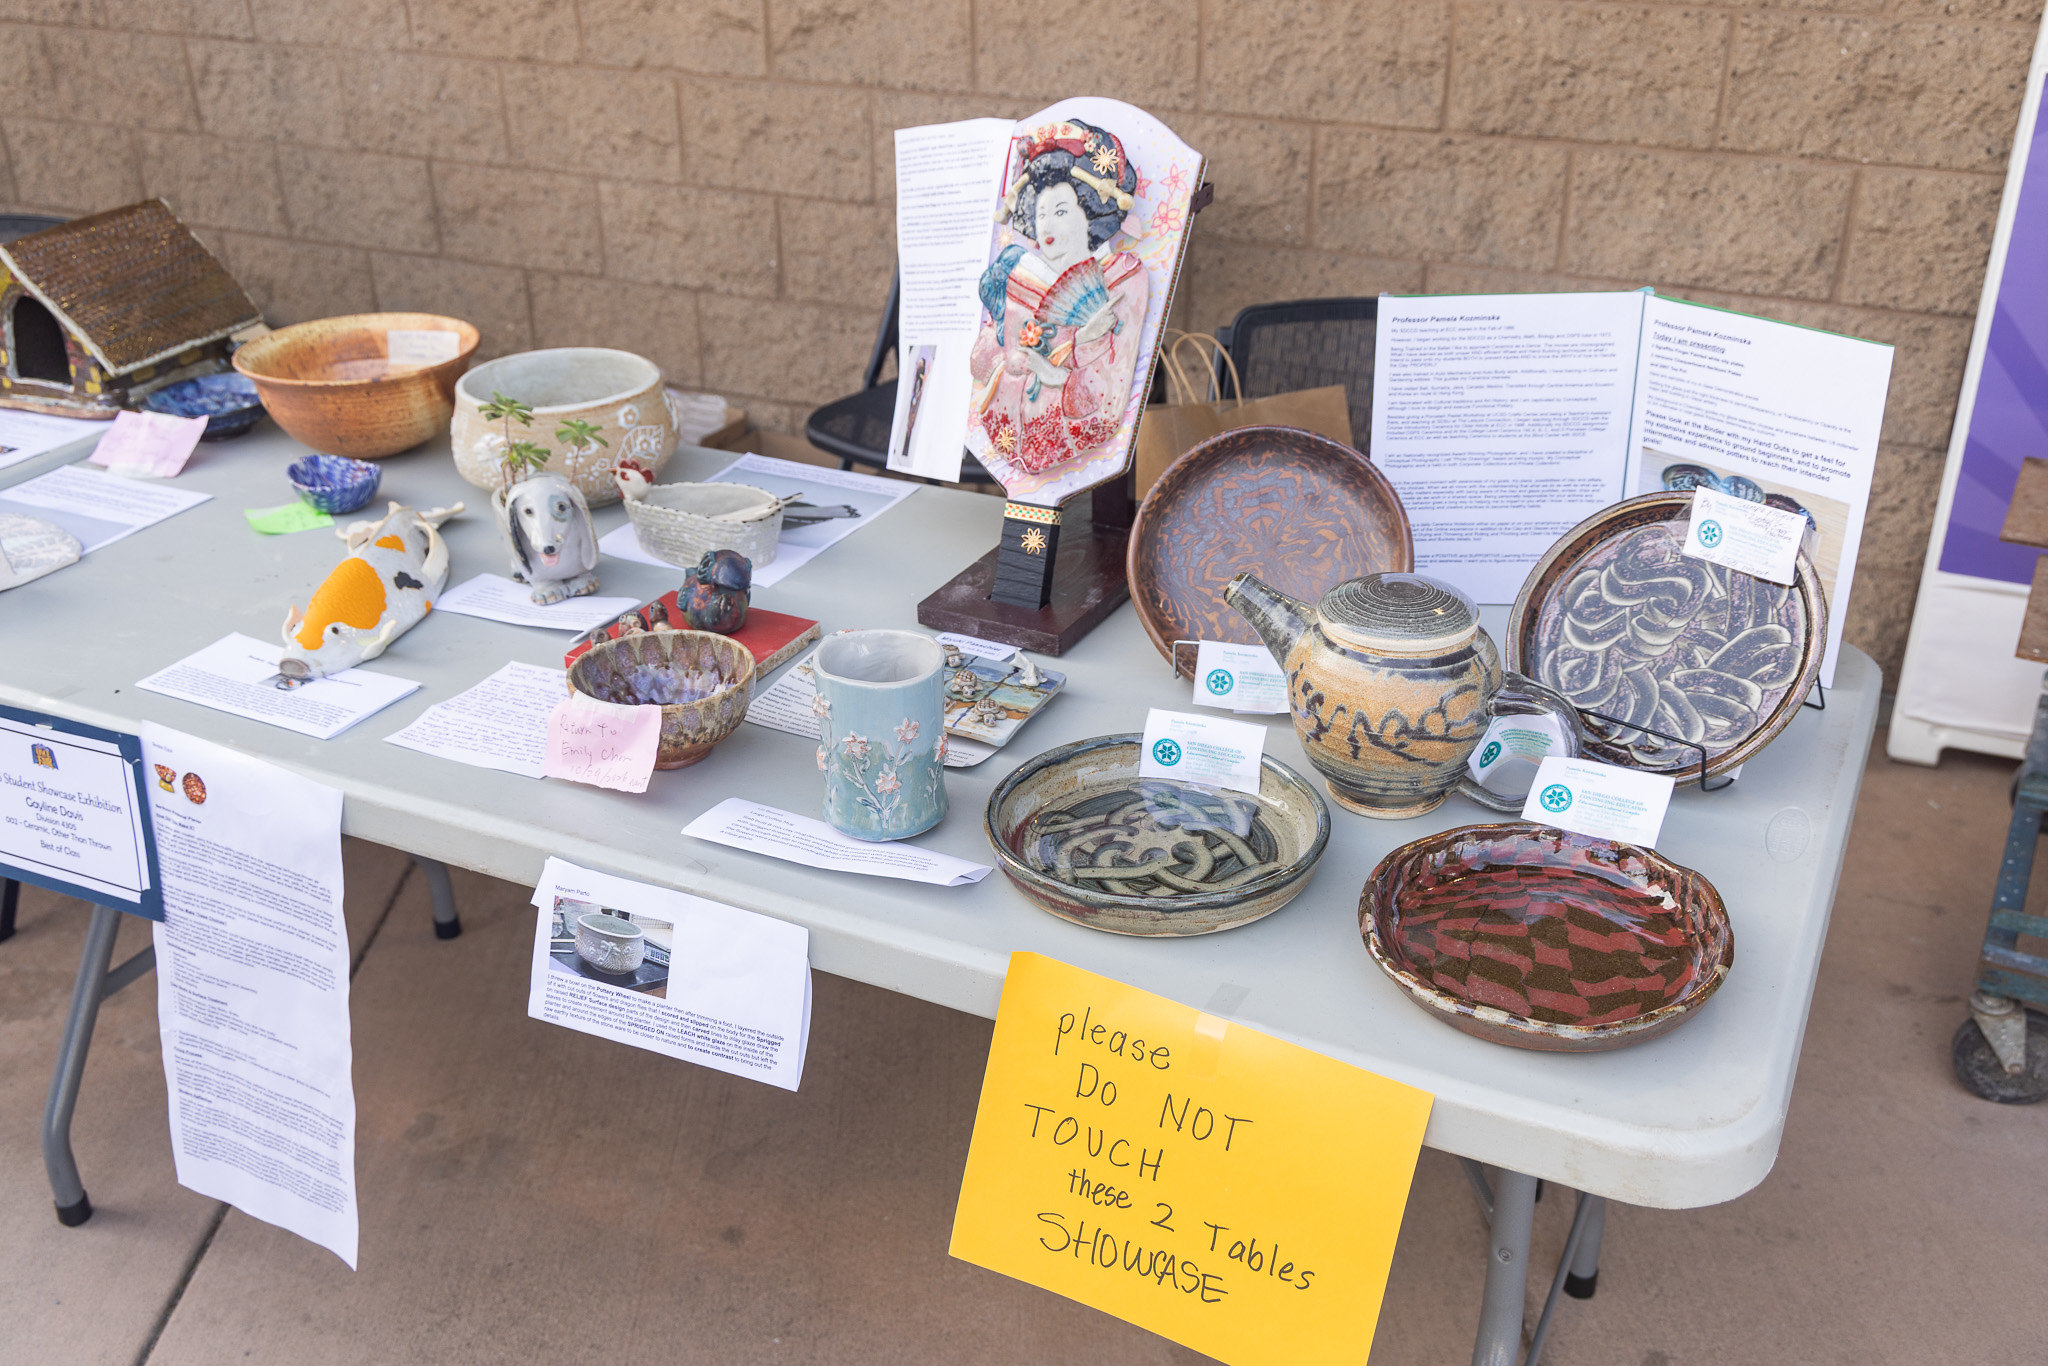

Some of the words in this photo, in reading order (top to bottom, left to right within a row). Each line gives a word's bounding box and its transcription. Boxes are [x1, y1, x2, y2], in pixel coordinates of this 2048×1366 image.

[1654, 319, 1685, 331] Professor
[1212, 745, 1233, 753] COLLEGE
[3, 772, 36, 791] Student
[37, 781, 76, 802] Showcase
[77, 792, 123, 814] Exhibition
[1592, 791, 1610, 799] DIEGO
[1611, 795, 1635, 804] COLLEGE
[60, 806, 83, 821] Davis
[40, 839, 54, 851] Best
[56, 845, 62, 853] of
[64, 846, 80, 858] Class
[556, 885, 575, 893] Maryam
[553, 987, 568, 995] raised
[569, 991, 586, 1000] RELIEF
[588, 997, 607, 1006] Surface
[608, 1002, 625, 1012] design
[653, 1014, 670, 1024] design
[692, 1025, 710, 1034] carved
[741, 1038, 755, 1047] glaze
[592, 991, 608, 1000] flowers
[619, 999, 636, 1008] dragon
[661, 1010, 678, 1019] scored
[690, 1018, 708, 1028] slipped
[726, 1028, 738, 1036] body
[756, 1036, 780, 1047] Sprigged
[596, 986, 614, 996] Pottery
[615, 991, 631, 1000] Wheel
[637, 997, 650, 1005] make
[656, 1002, 672, 1012] planter
[696, 1013, 717, 1024] trimming
[722, 1020, 733, 1028] foot,
[737, 1024, 755, 1034] layered
[765, 1032, 784, 1041] outside
[627, 1020, 655, 1032] SPRIGGED
[677, 1027, 695, 1036] LEACH
[696, 1033, 710, 1041] white
[711, 1037, 725, 1045] glaze
[1054, 1006, 1170, 1071] please
[694, 1045, 710, 1054] create
[711, 1050, 733, 1060] contrast
[1159, 1093, 1254, 1152] NOT
[1024, 1103, 1164, 1181] TOUCH
[1067, 1168, 1133, 1209] these
[1150, 1203, 1175, 1232] 2
[1203, 1221, 1315, 1291] Tables
[1036, 1212, 1229, 1304] SHOWCASE
